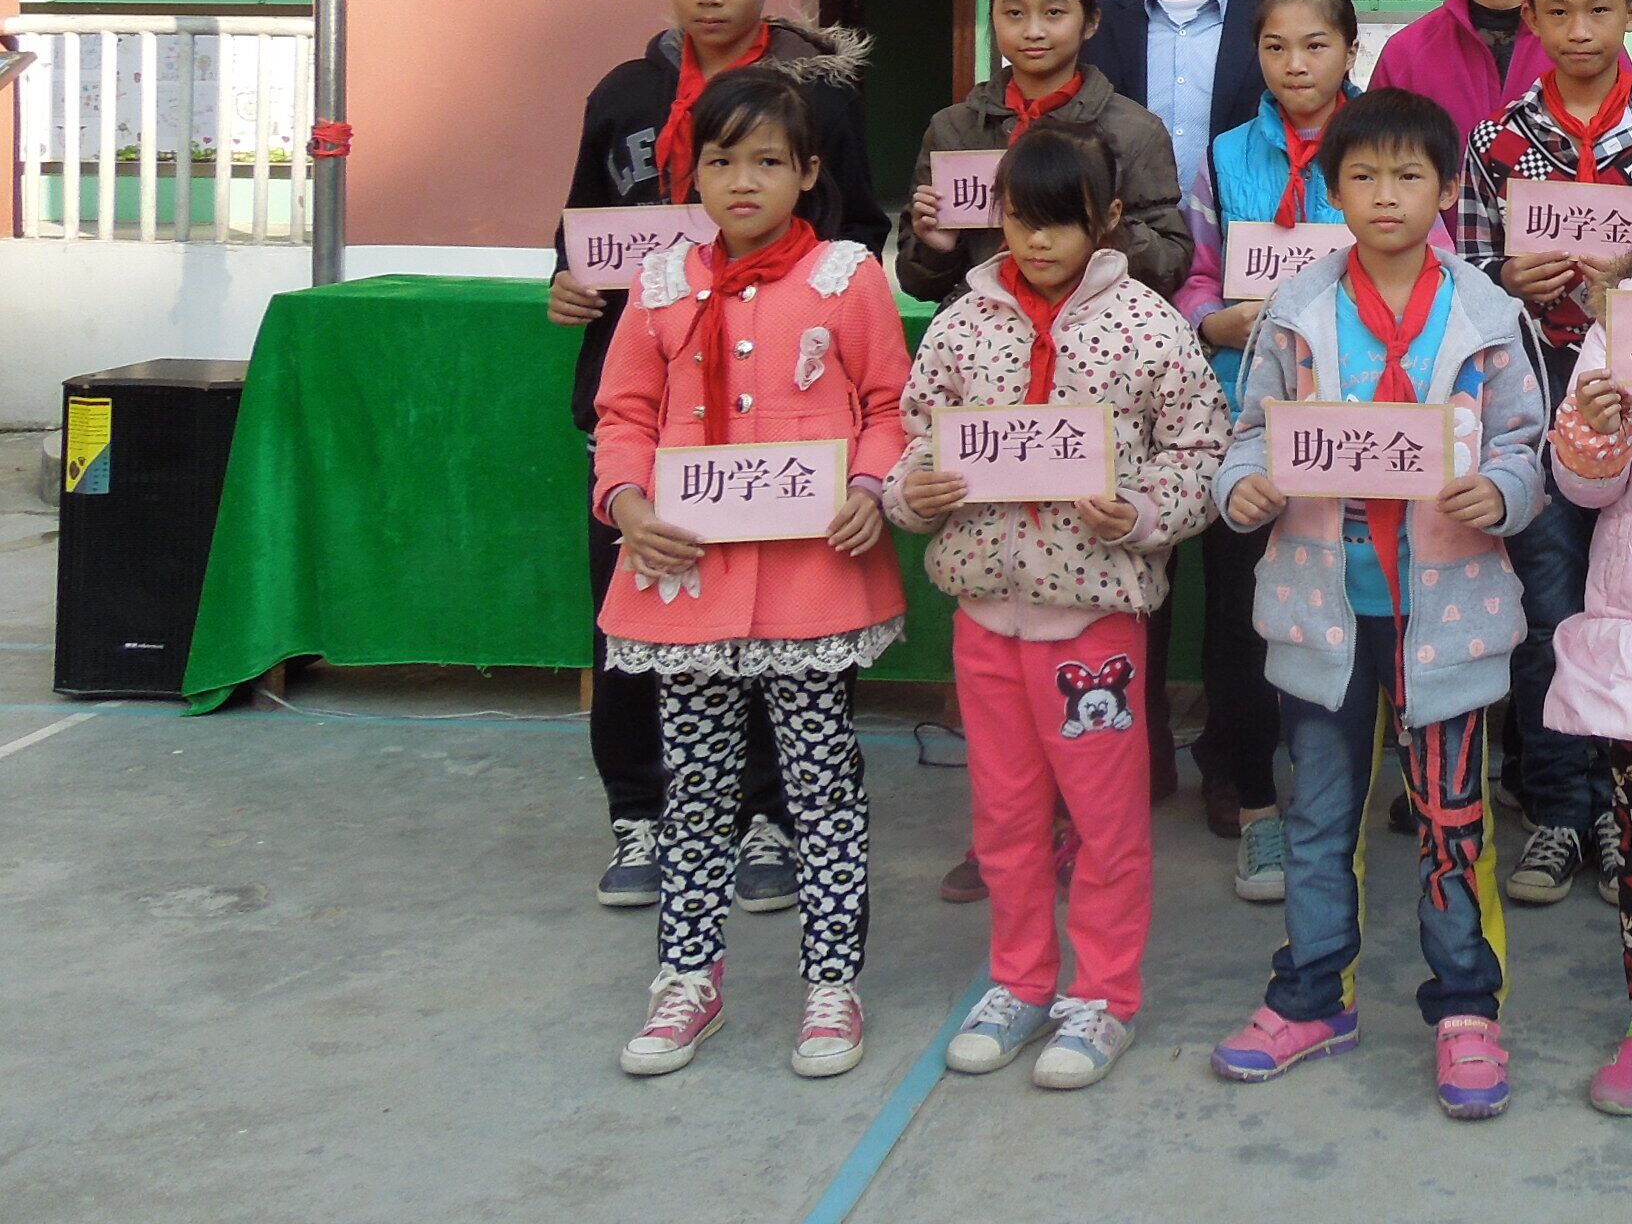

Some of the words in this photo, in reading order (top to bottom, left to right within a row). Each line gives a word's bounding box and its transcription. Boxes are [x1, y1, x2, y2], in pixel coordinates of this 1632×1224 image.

[952, 175, 996, 211] 助
[1525, 204, 1632, 244] 助学金
[1244, 246, 1338, 281] 助学
[959, 418, 1087, 464] 助学金
[1292, 427, 1425, 473] 助学金
[680, 457, 817, 505] 助学金
